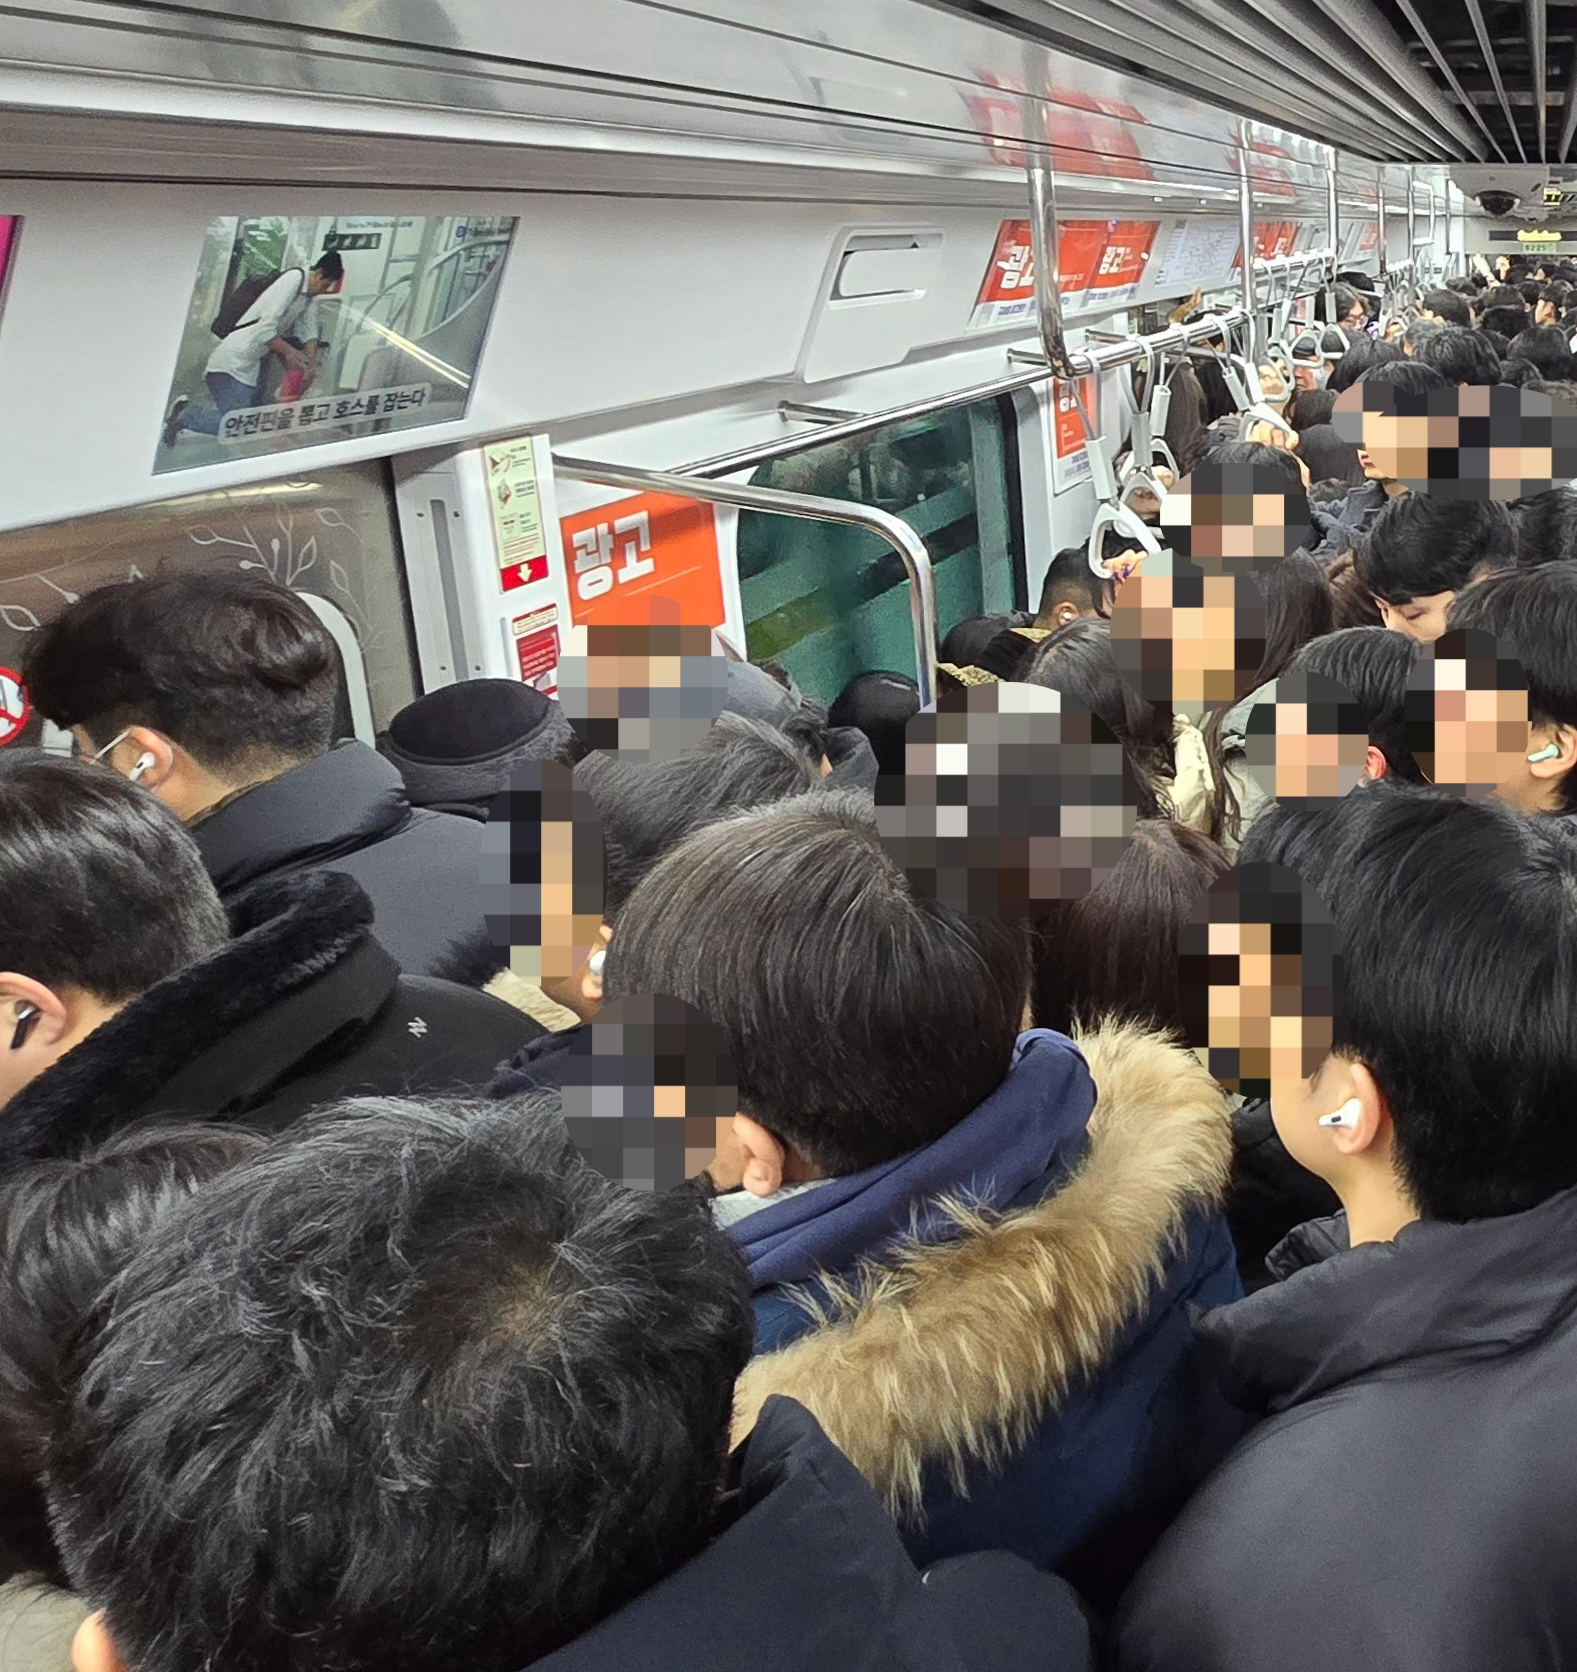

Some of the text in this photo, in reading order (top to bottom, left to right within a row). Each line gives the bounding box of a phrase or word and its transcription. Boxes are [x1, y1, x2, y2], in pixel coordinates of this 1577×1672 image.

[224, 387, 427, 439] 안전핀을 뽑고 호스를 잡는다
[571, 509, 656, 601] 광고
